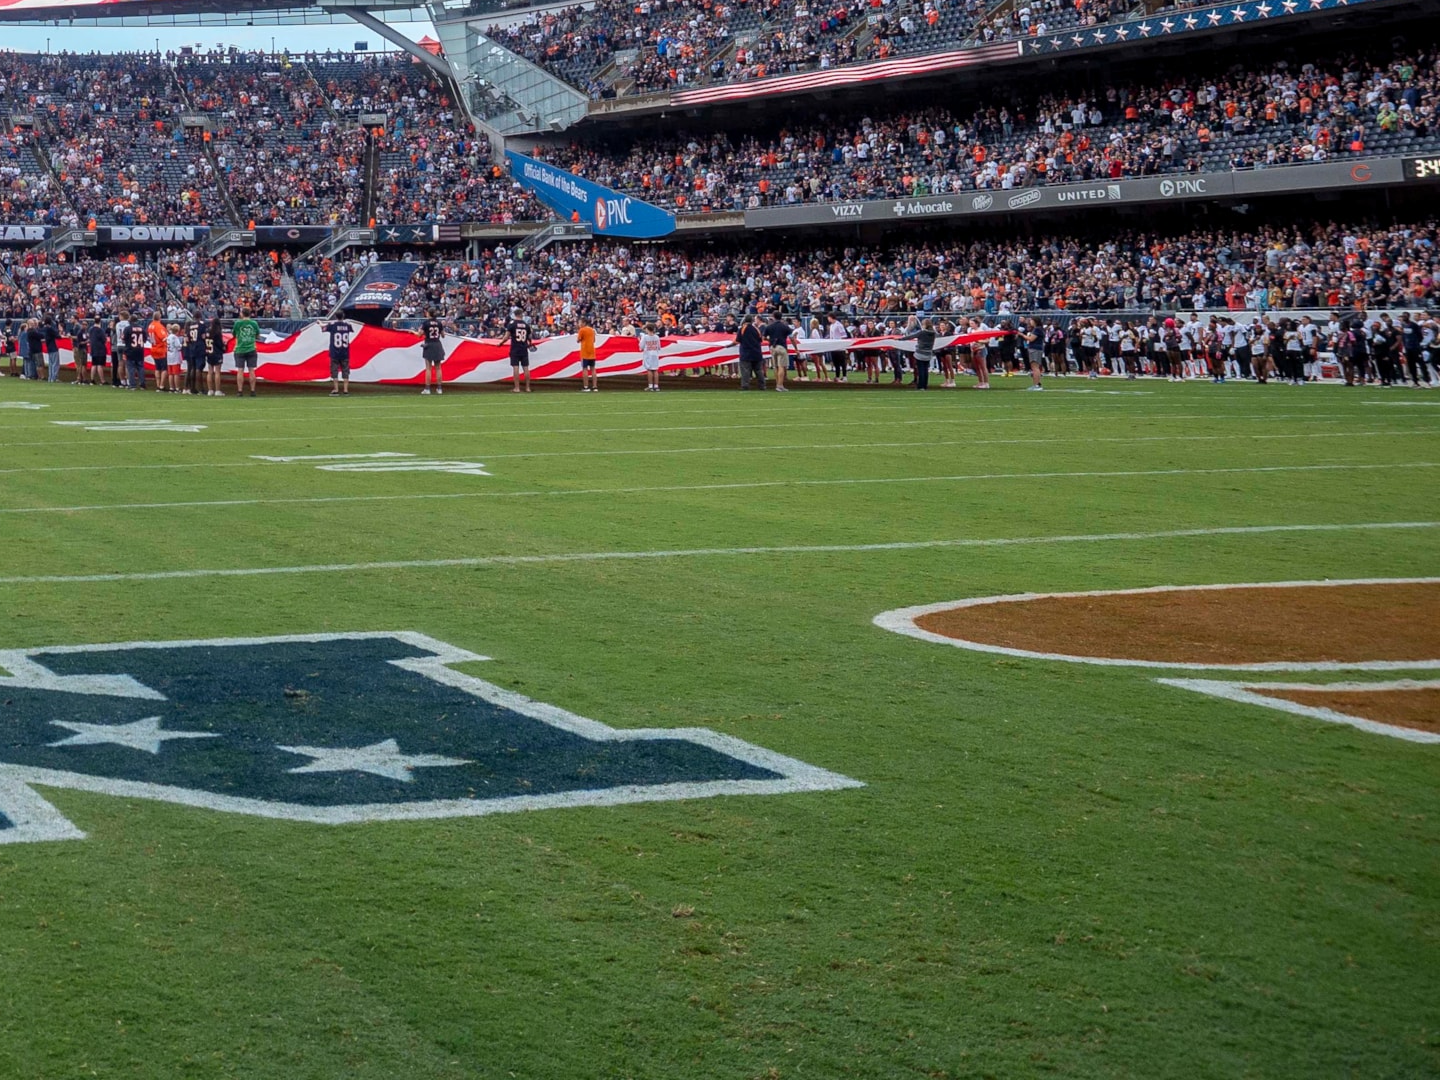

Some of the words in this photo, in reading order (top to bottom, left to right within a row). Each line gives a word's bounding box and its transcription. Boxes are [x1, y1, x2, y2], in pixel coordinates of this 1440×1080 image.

[1414, 159, 1440, 178] 3:4
[524, 162, 541, 181] Official
[542, 168, 555, 187] Bank
[555, 174, 561, 190] of
[561, 176, 571, 194] the
[570, 180, 588, 203] Bears
[1176, 178, 1206, 194] PNC
[1010, 190, 1038, 207] snapple
[1058, 189, 1106, 201] UNITED
[606, 197, 632, 226] PNC
[832, 204, 864, 216] VIZZY
[907, 200, 953, 215] Advocate
[110, 227, 194, 240] DOWN
[334, 332, 350, 348] 89
[429, 327, 440, 338] 23
[515, 330, 527, 342] 58
[130, 333, 144, 348] 34
